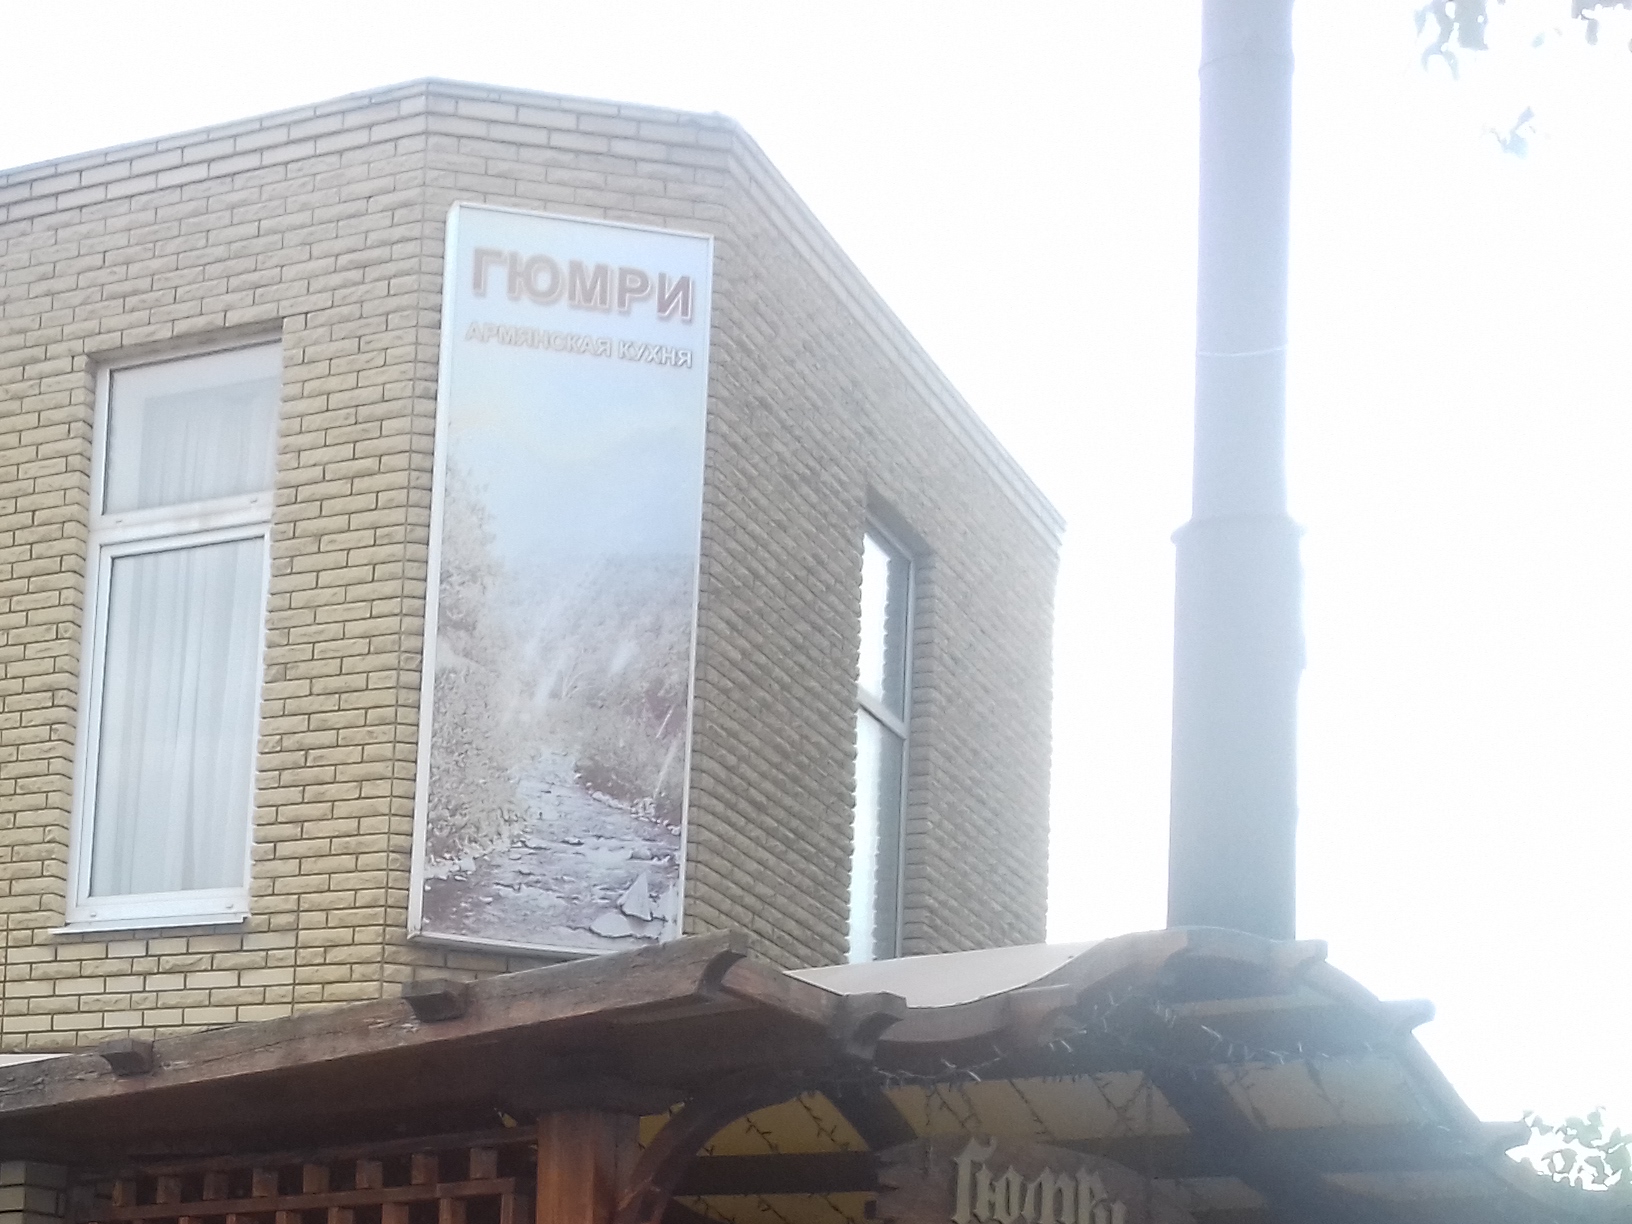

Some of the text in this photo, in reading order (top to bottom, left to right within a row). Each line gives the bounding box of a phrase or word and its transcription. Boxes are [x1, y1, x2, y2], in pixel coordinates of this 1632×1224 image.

[471, 246, 696, 323] ГЮМРИ
[465, 321, 694, 369] АРМЯНСКАЯ КУХНЯ
